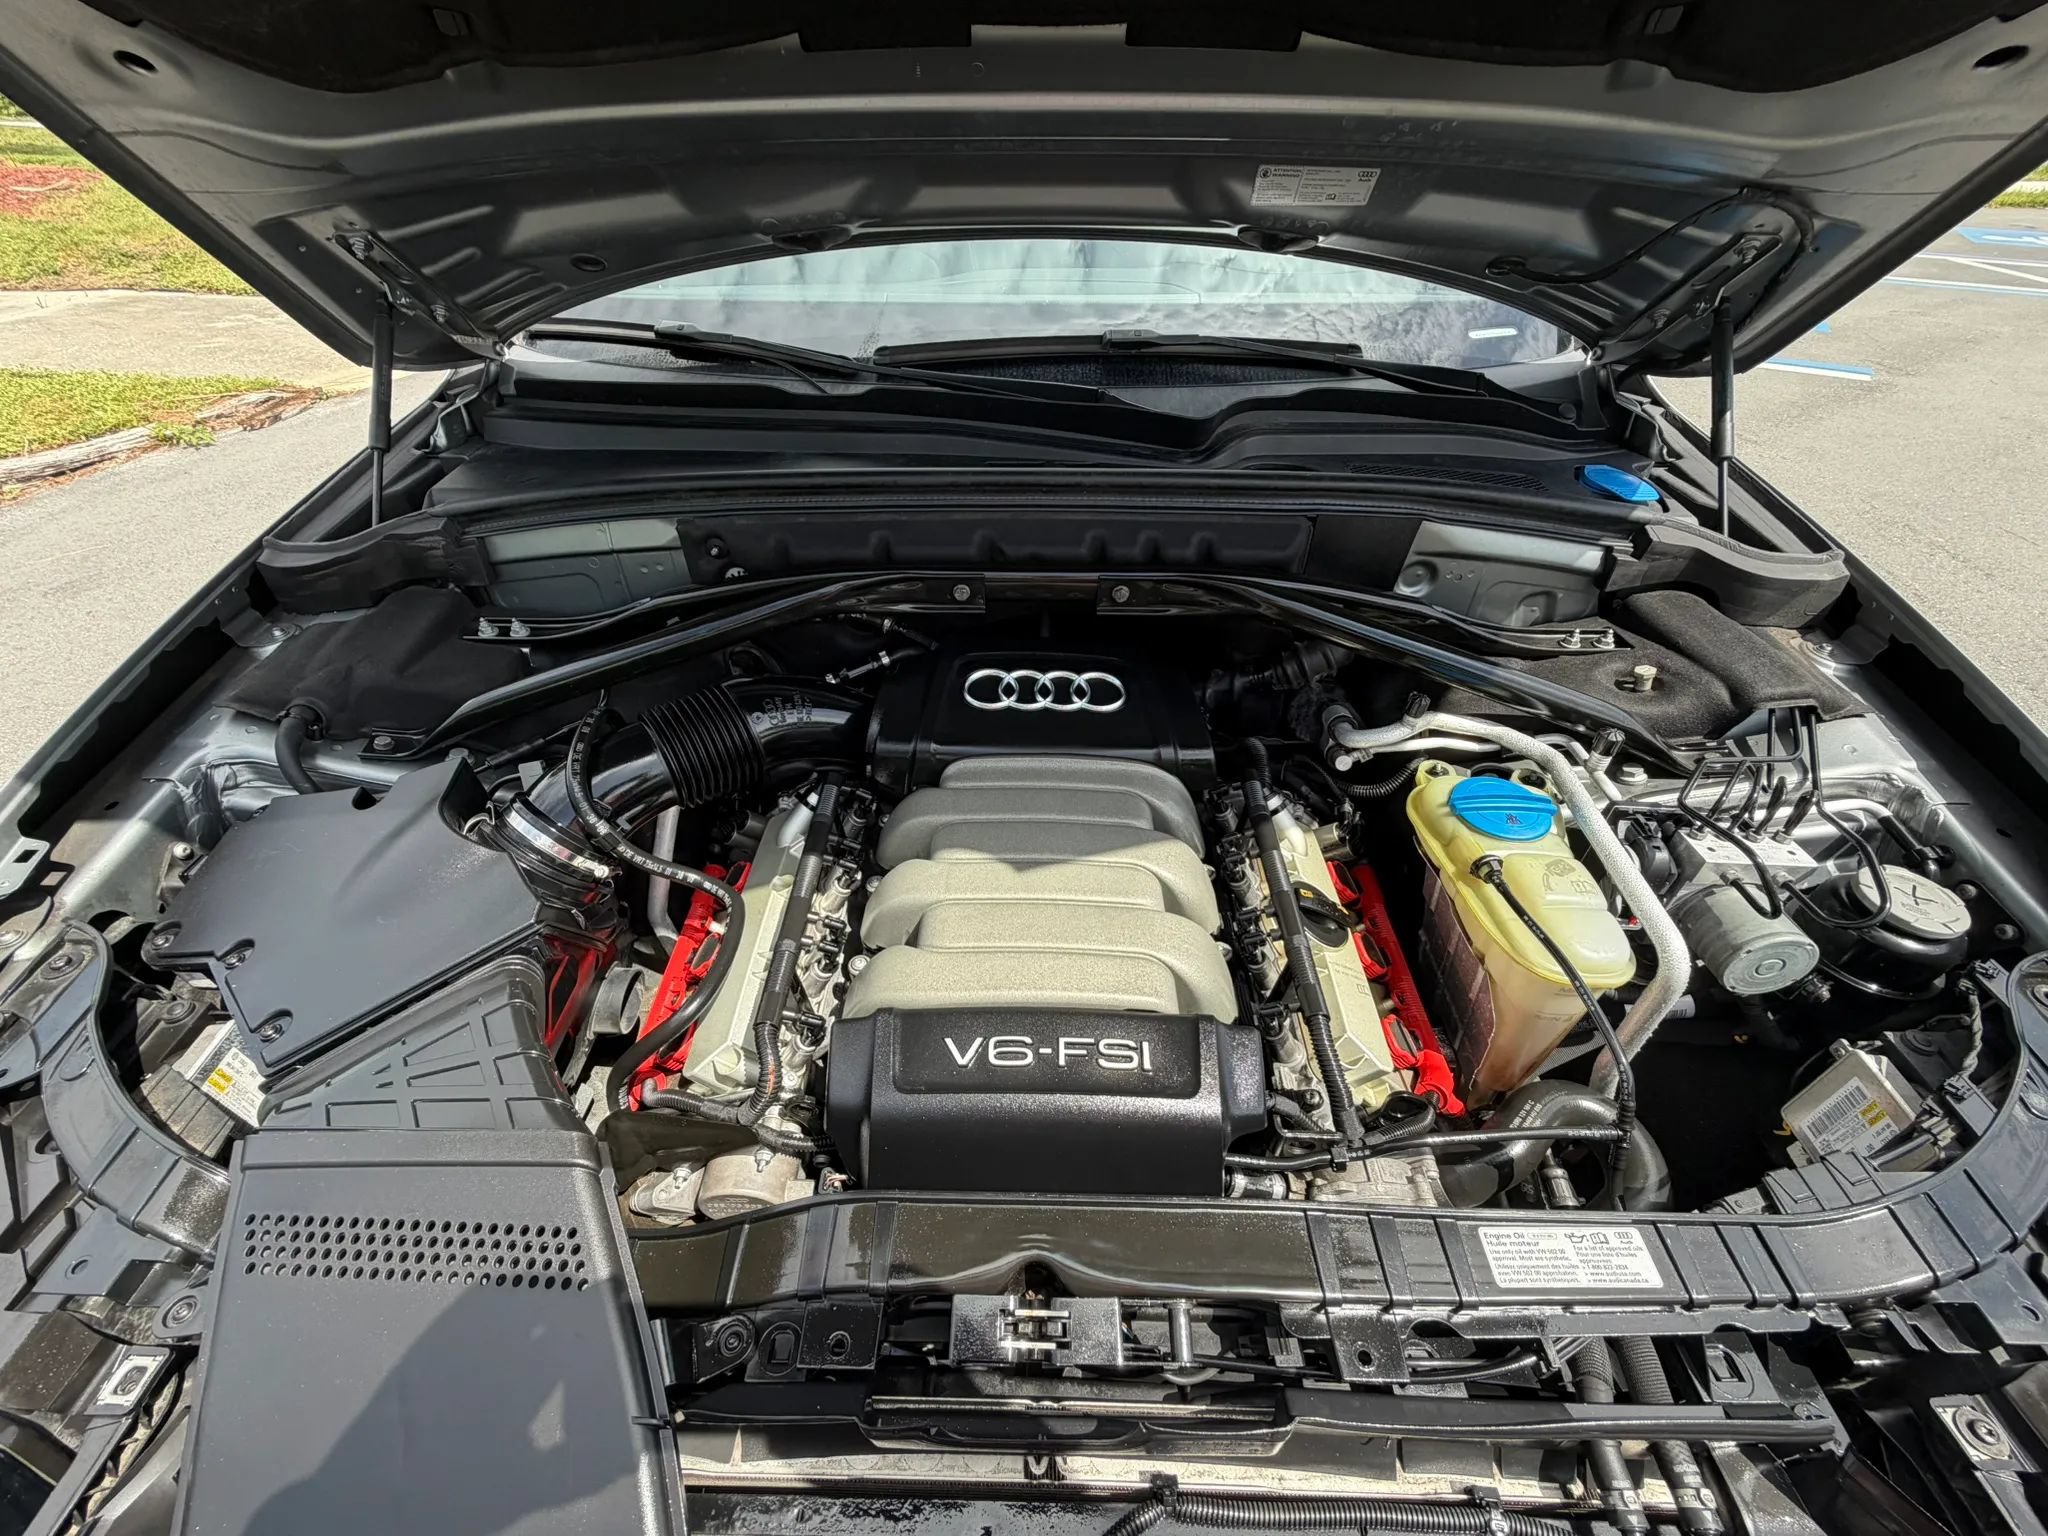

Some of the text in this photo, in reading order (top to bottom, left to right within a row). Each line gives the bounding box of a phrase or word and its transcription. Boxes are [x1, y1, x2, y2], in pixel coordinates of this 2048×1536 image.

[943, 1035, 1153, 1073] V6-FSI
[1483, 1231, 1512, 1241] Engine
[1513, 1231, 1525, 1240] Oil
